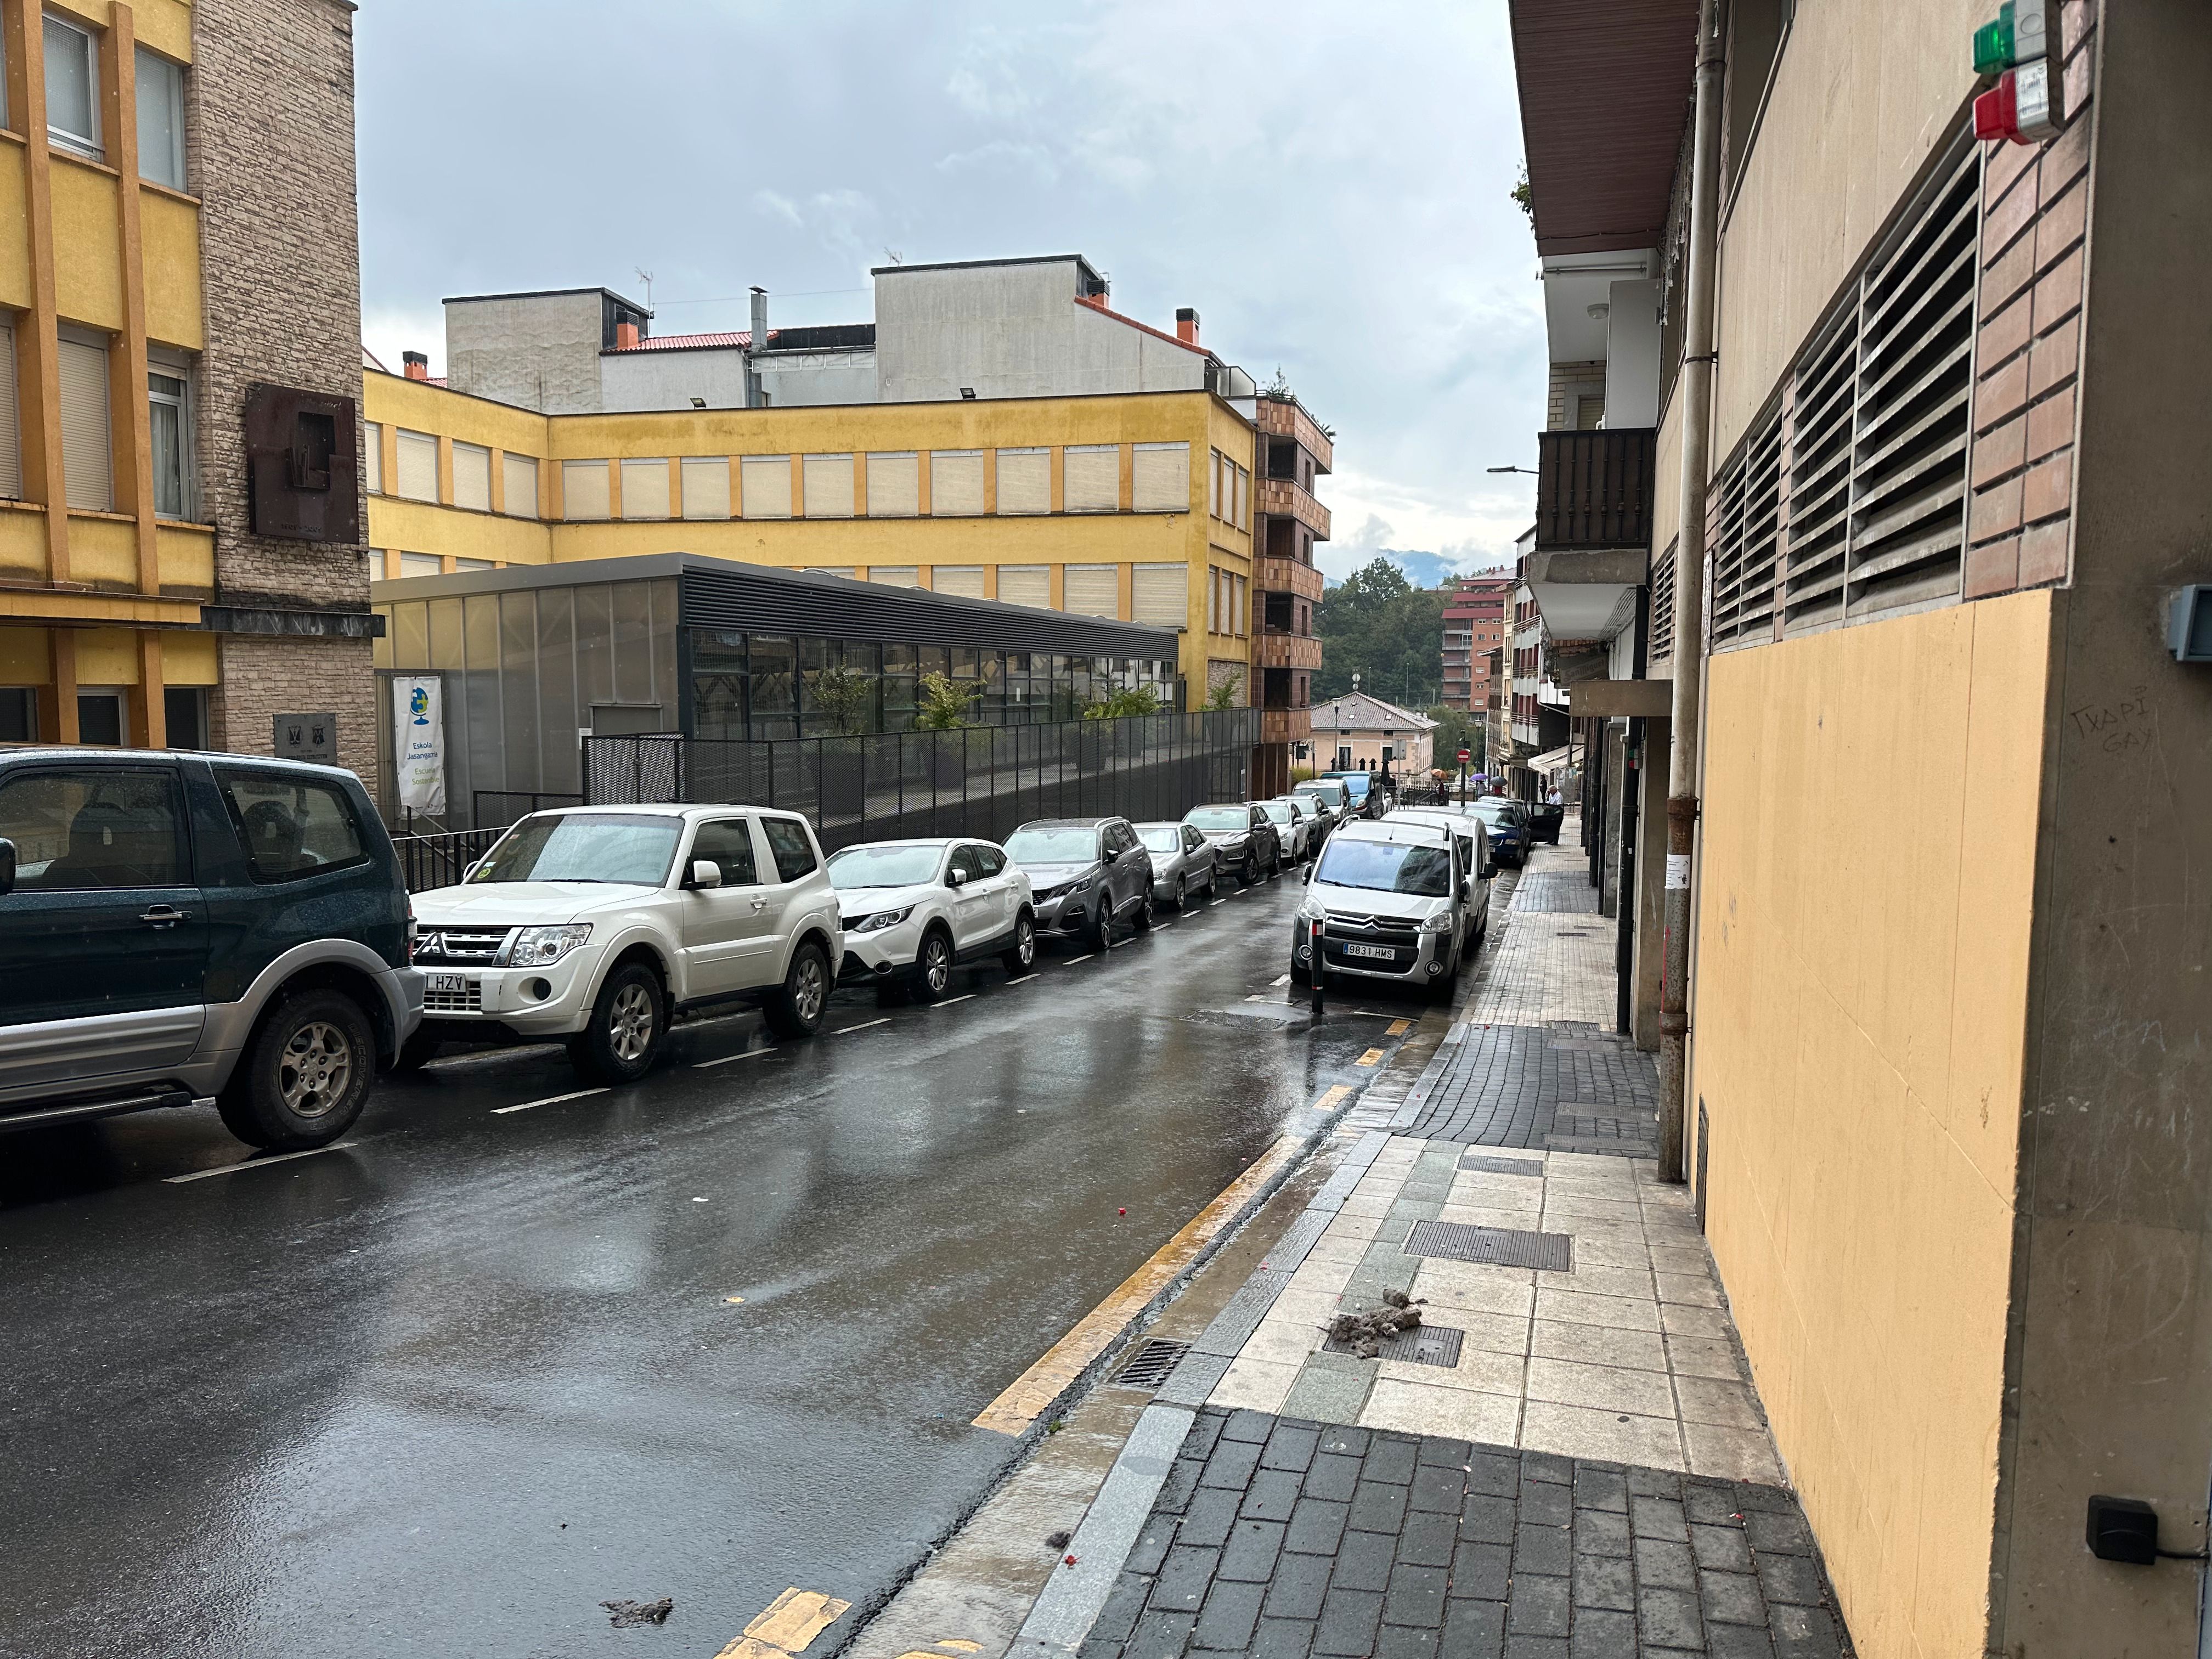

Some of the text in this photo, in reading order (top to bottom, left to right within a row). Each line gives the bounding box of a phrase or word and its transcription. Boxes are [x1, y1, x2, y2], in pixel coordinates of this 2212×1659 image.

[2102, 727, 2151, 755] GAY
[411, 776, 440, 785] Sostenible
[1349, 945, 1392, 958] 9831 HMS
[436, 975, 462, 990] HZV
[340, 1023, 367, 1116] DISCOVERER
